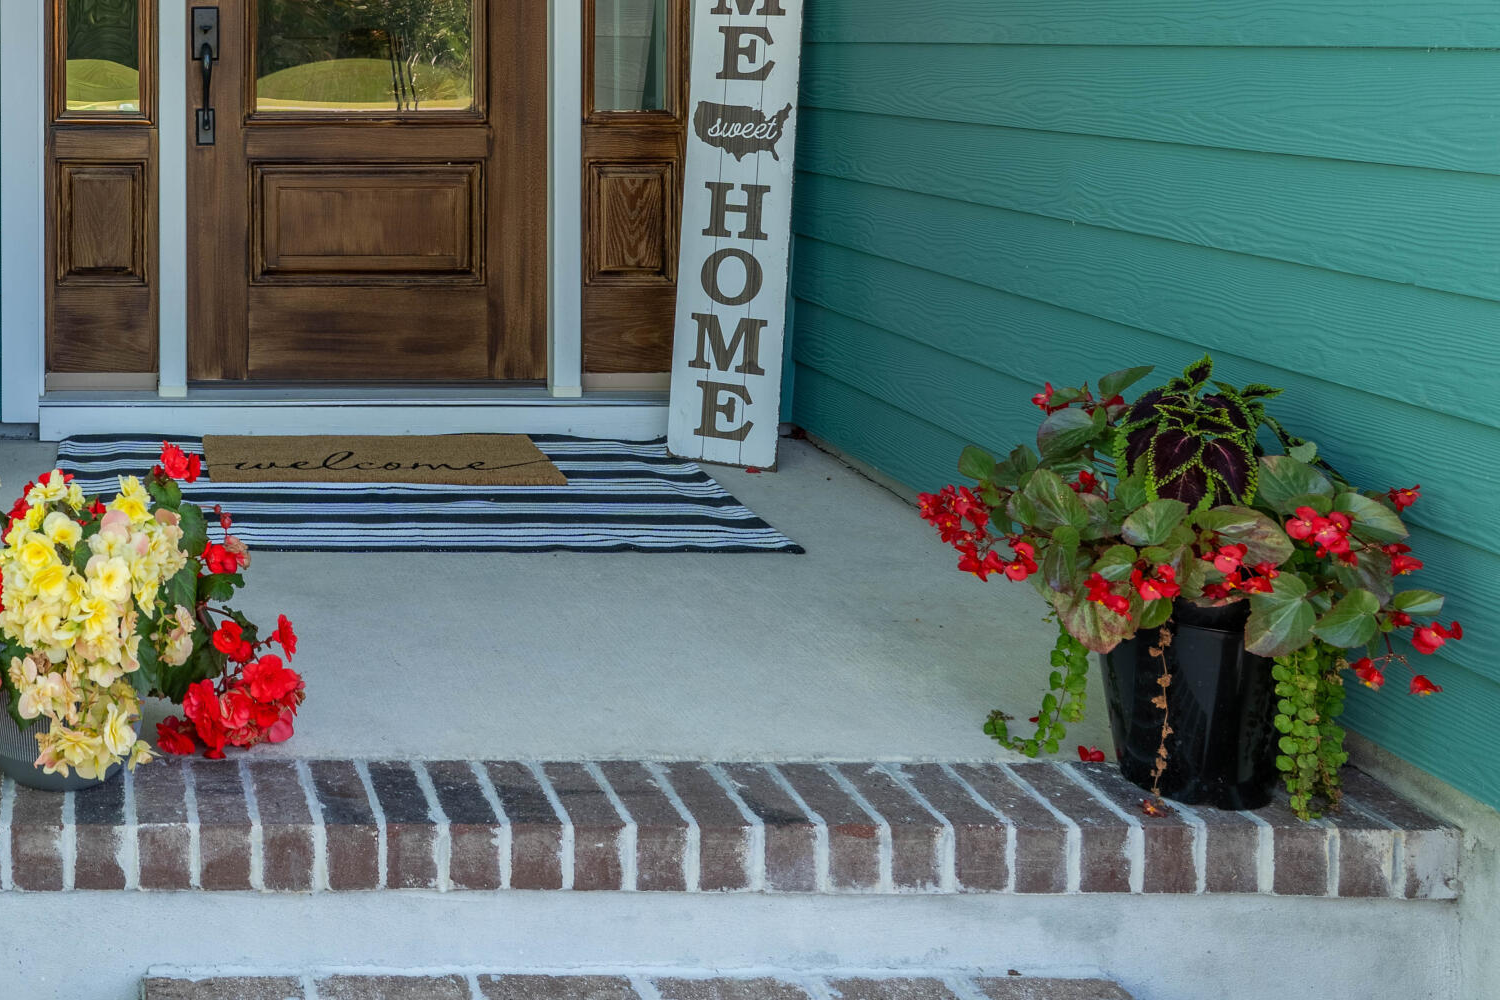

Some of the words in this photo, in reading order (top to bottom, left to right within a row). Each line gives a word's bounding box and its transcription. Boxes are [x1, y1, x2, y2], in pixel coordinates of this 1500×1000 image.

[707, 115, 778, 140] sweet
[688, 181, 771, 442] HOME
[210, 450, 551, 471] welcome
